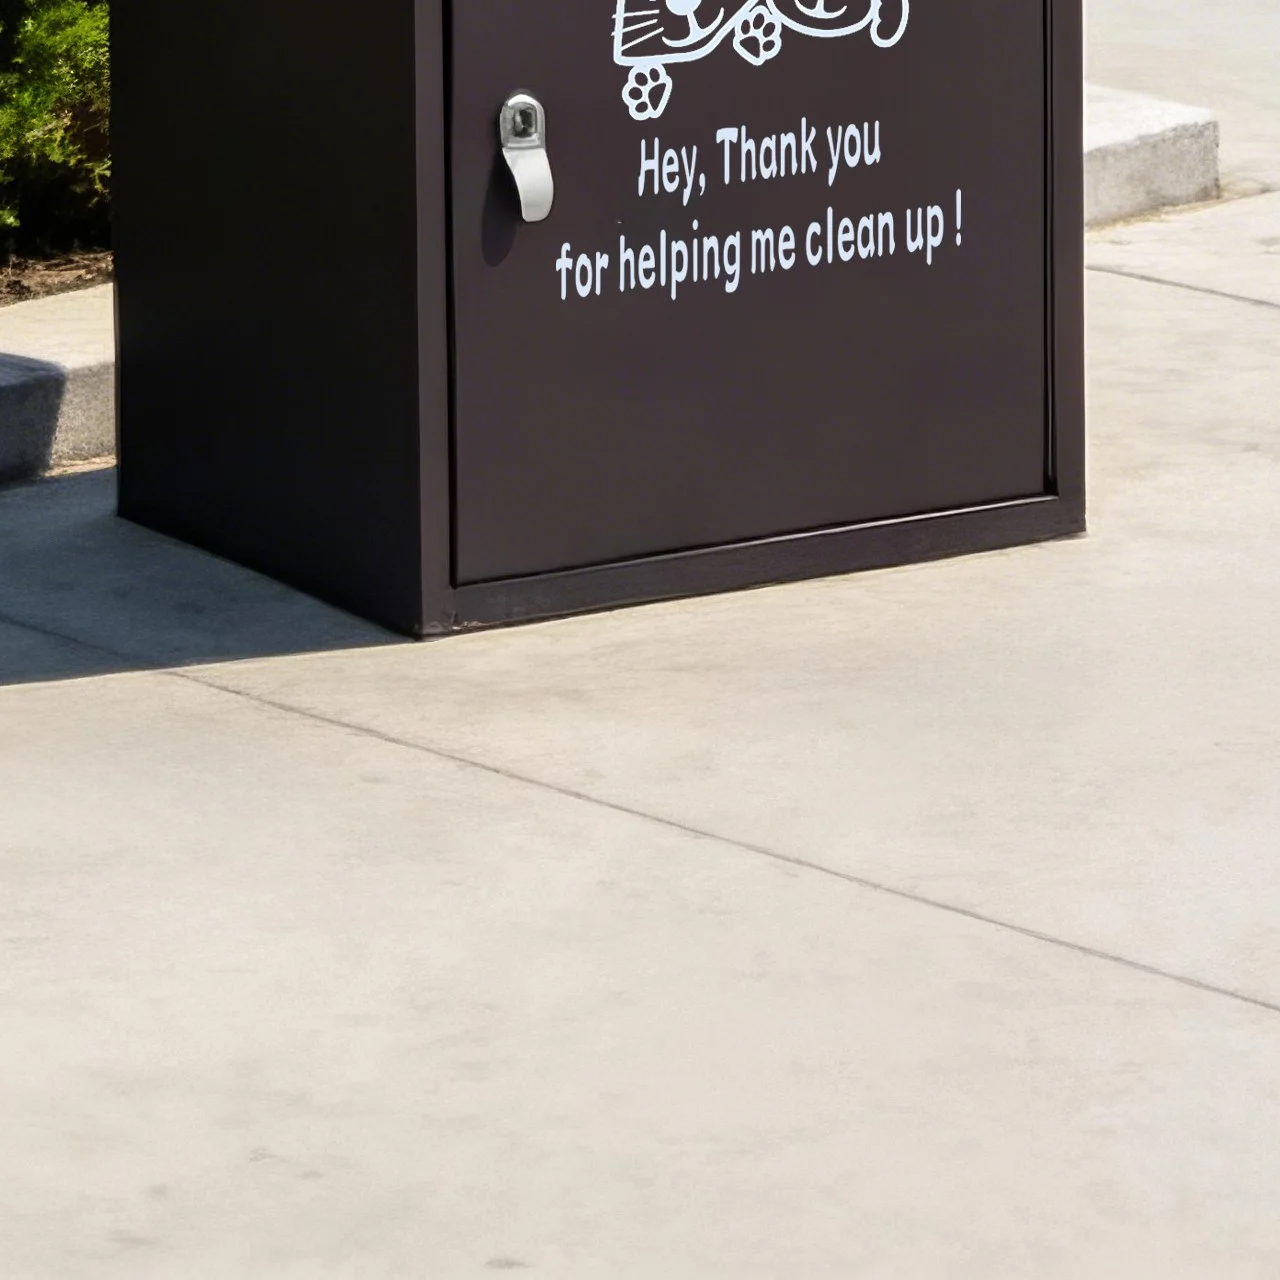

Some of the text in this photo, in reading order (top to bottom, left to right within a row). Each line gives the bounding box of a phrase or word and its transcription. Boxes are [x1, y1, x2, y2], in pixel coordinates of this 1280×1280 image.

[637, 116, 882, 207] Hey, Thank you
[555, 241, 610, 301] for
[619, 218, 741, 301] helping
[750, 224, 796, 275] me
[805, 206, 896, 267] clean
